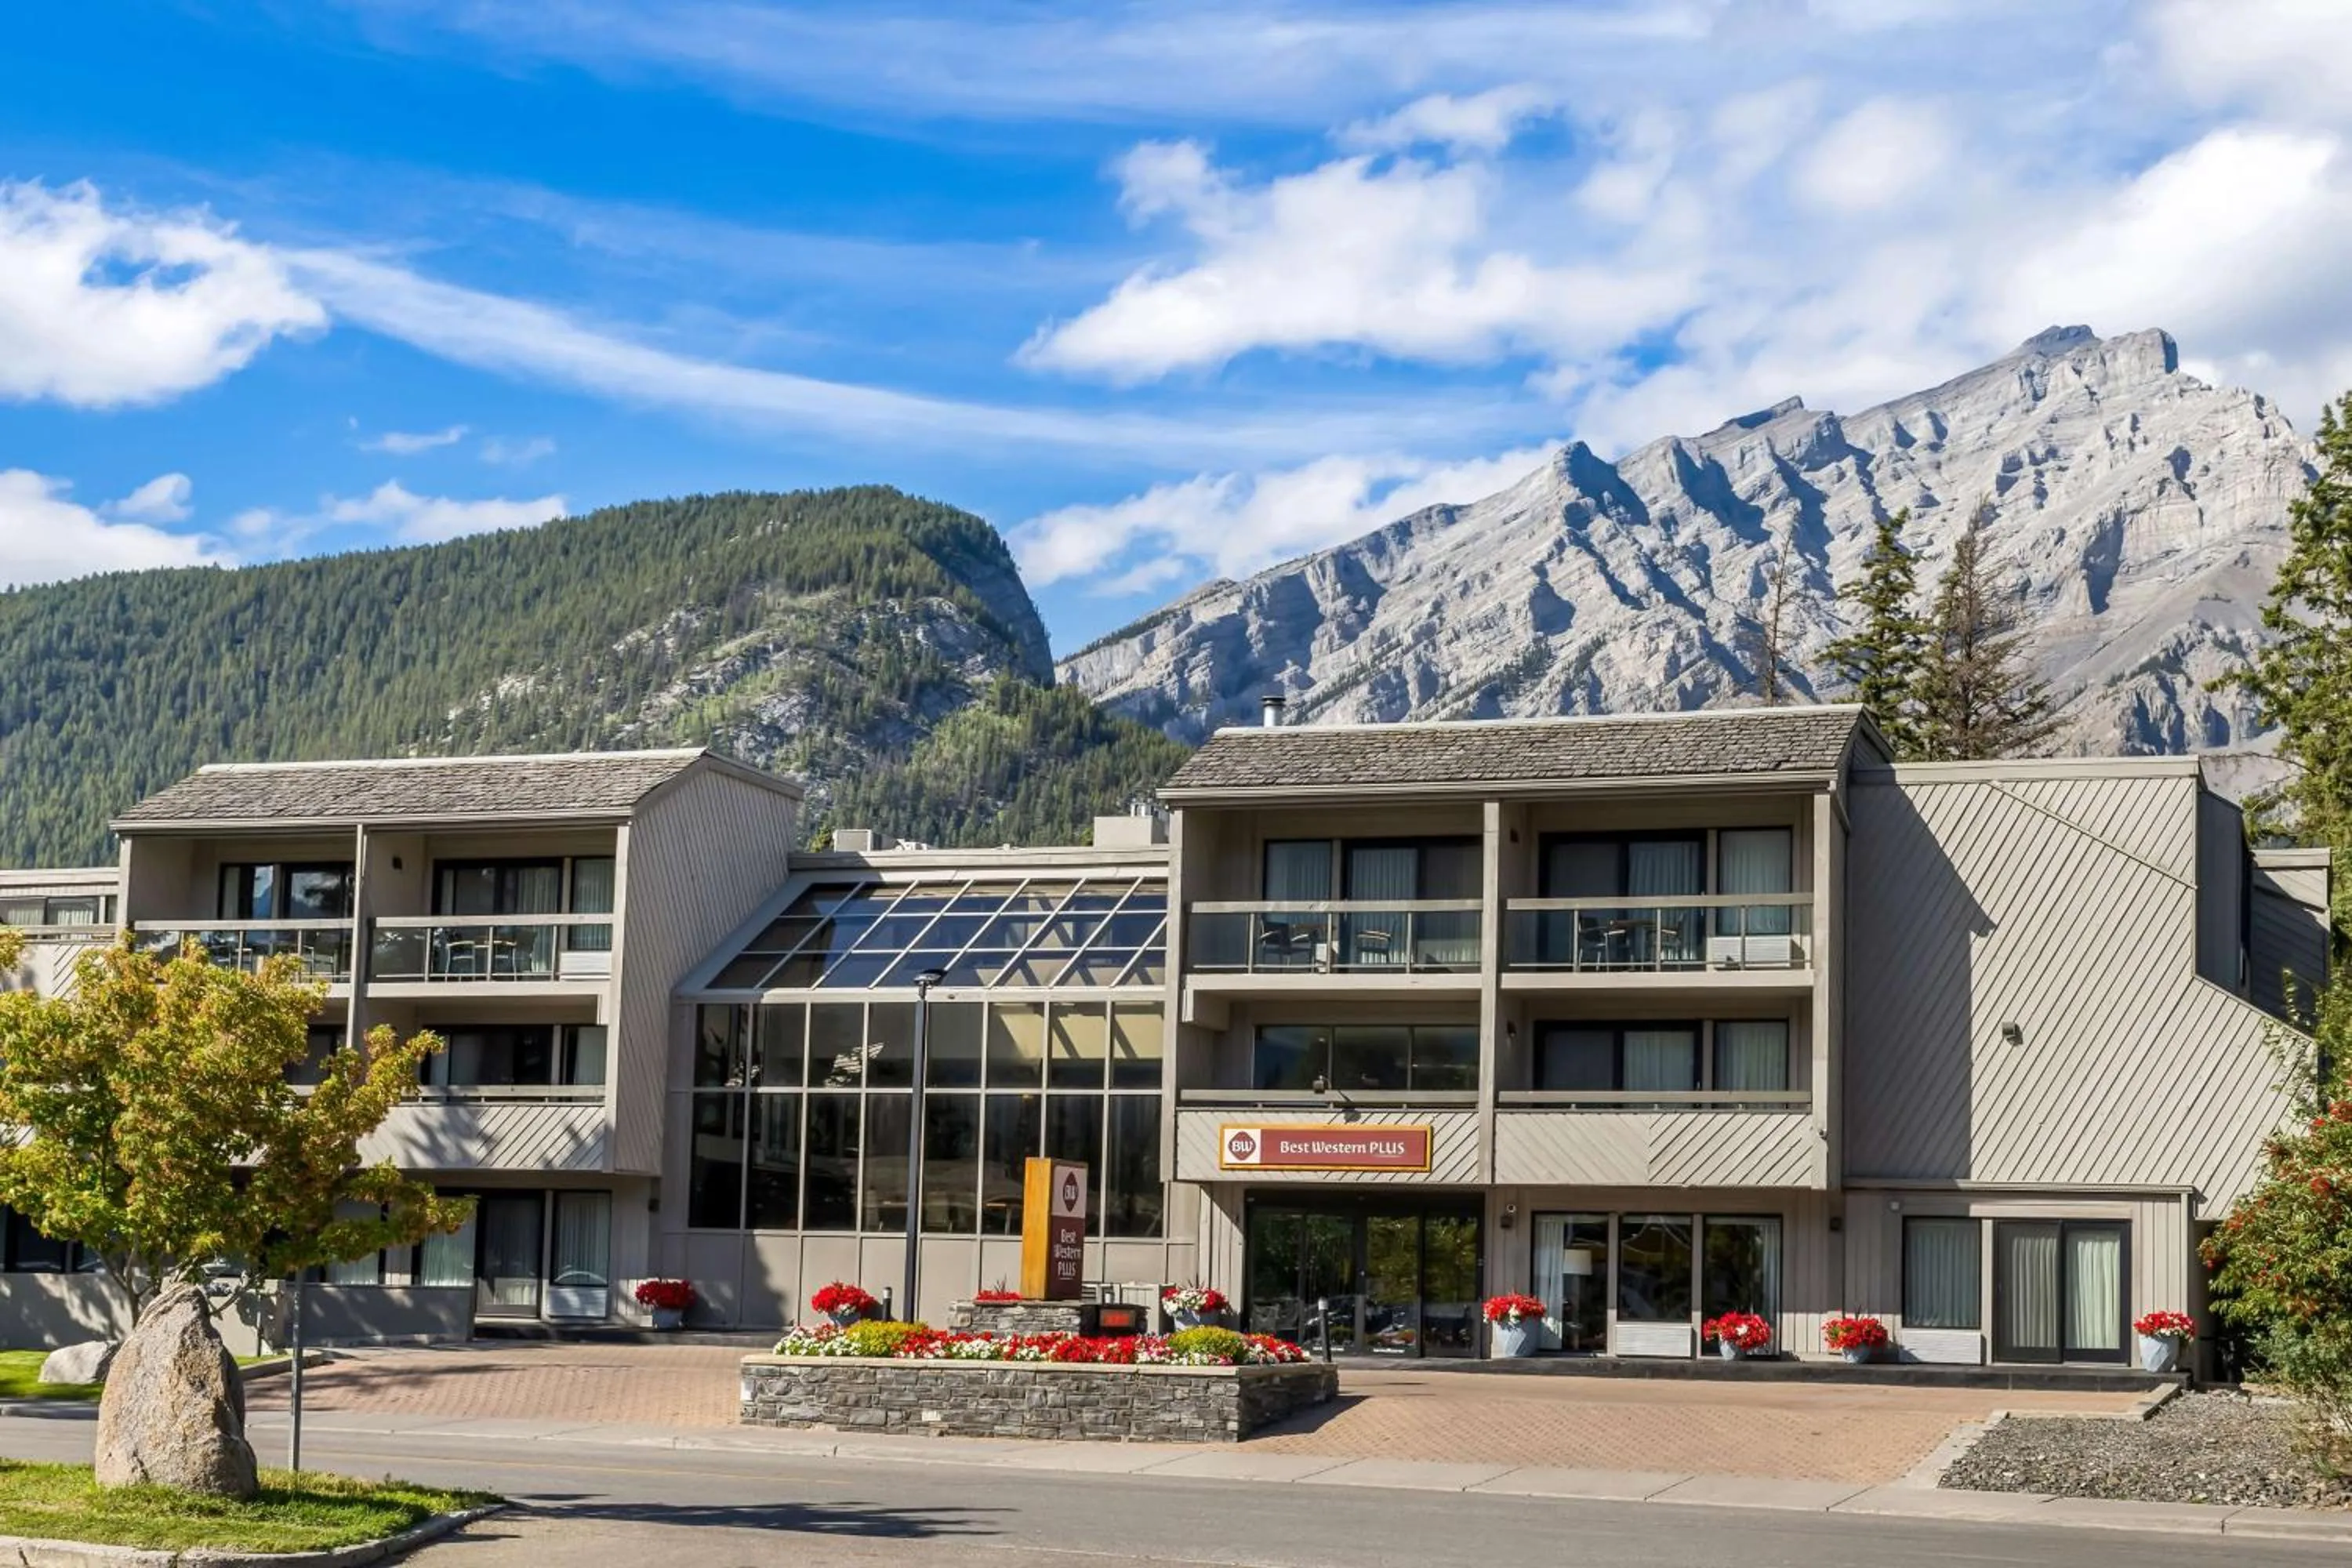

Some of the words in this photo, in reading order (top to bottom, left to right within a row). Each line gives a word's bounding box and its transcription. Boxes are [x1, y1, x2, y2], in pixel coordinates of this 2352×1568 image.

[1231, 1141, 1253, 1152] BW
[1280, 1141, 1309, 1153] Best
[1312, 1141, 1367, 1153] Western
[1369, 1142, 1405, 1154] PLUS
[1061, 1229, 1076, 1243] Best
[1053, 1243, 1081, 1259] Western
[1058, 1261, 1076, 1276] PLUS
